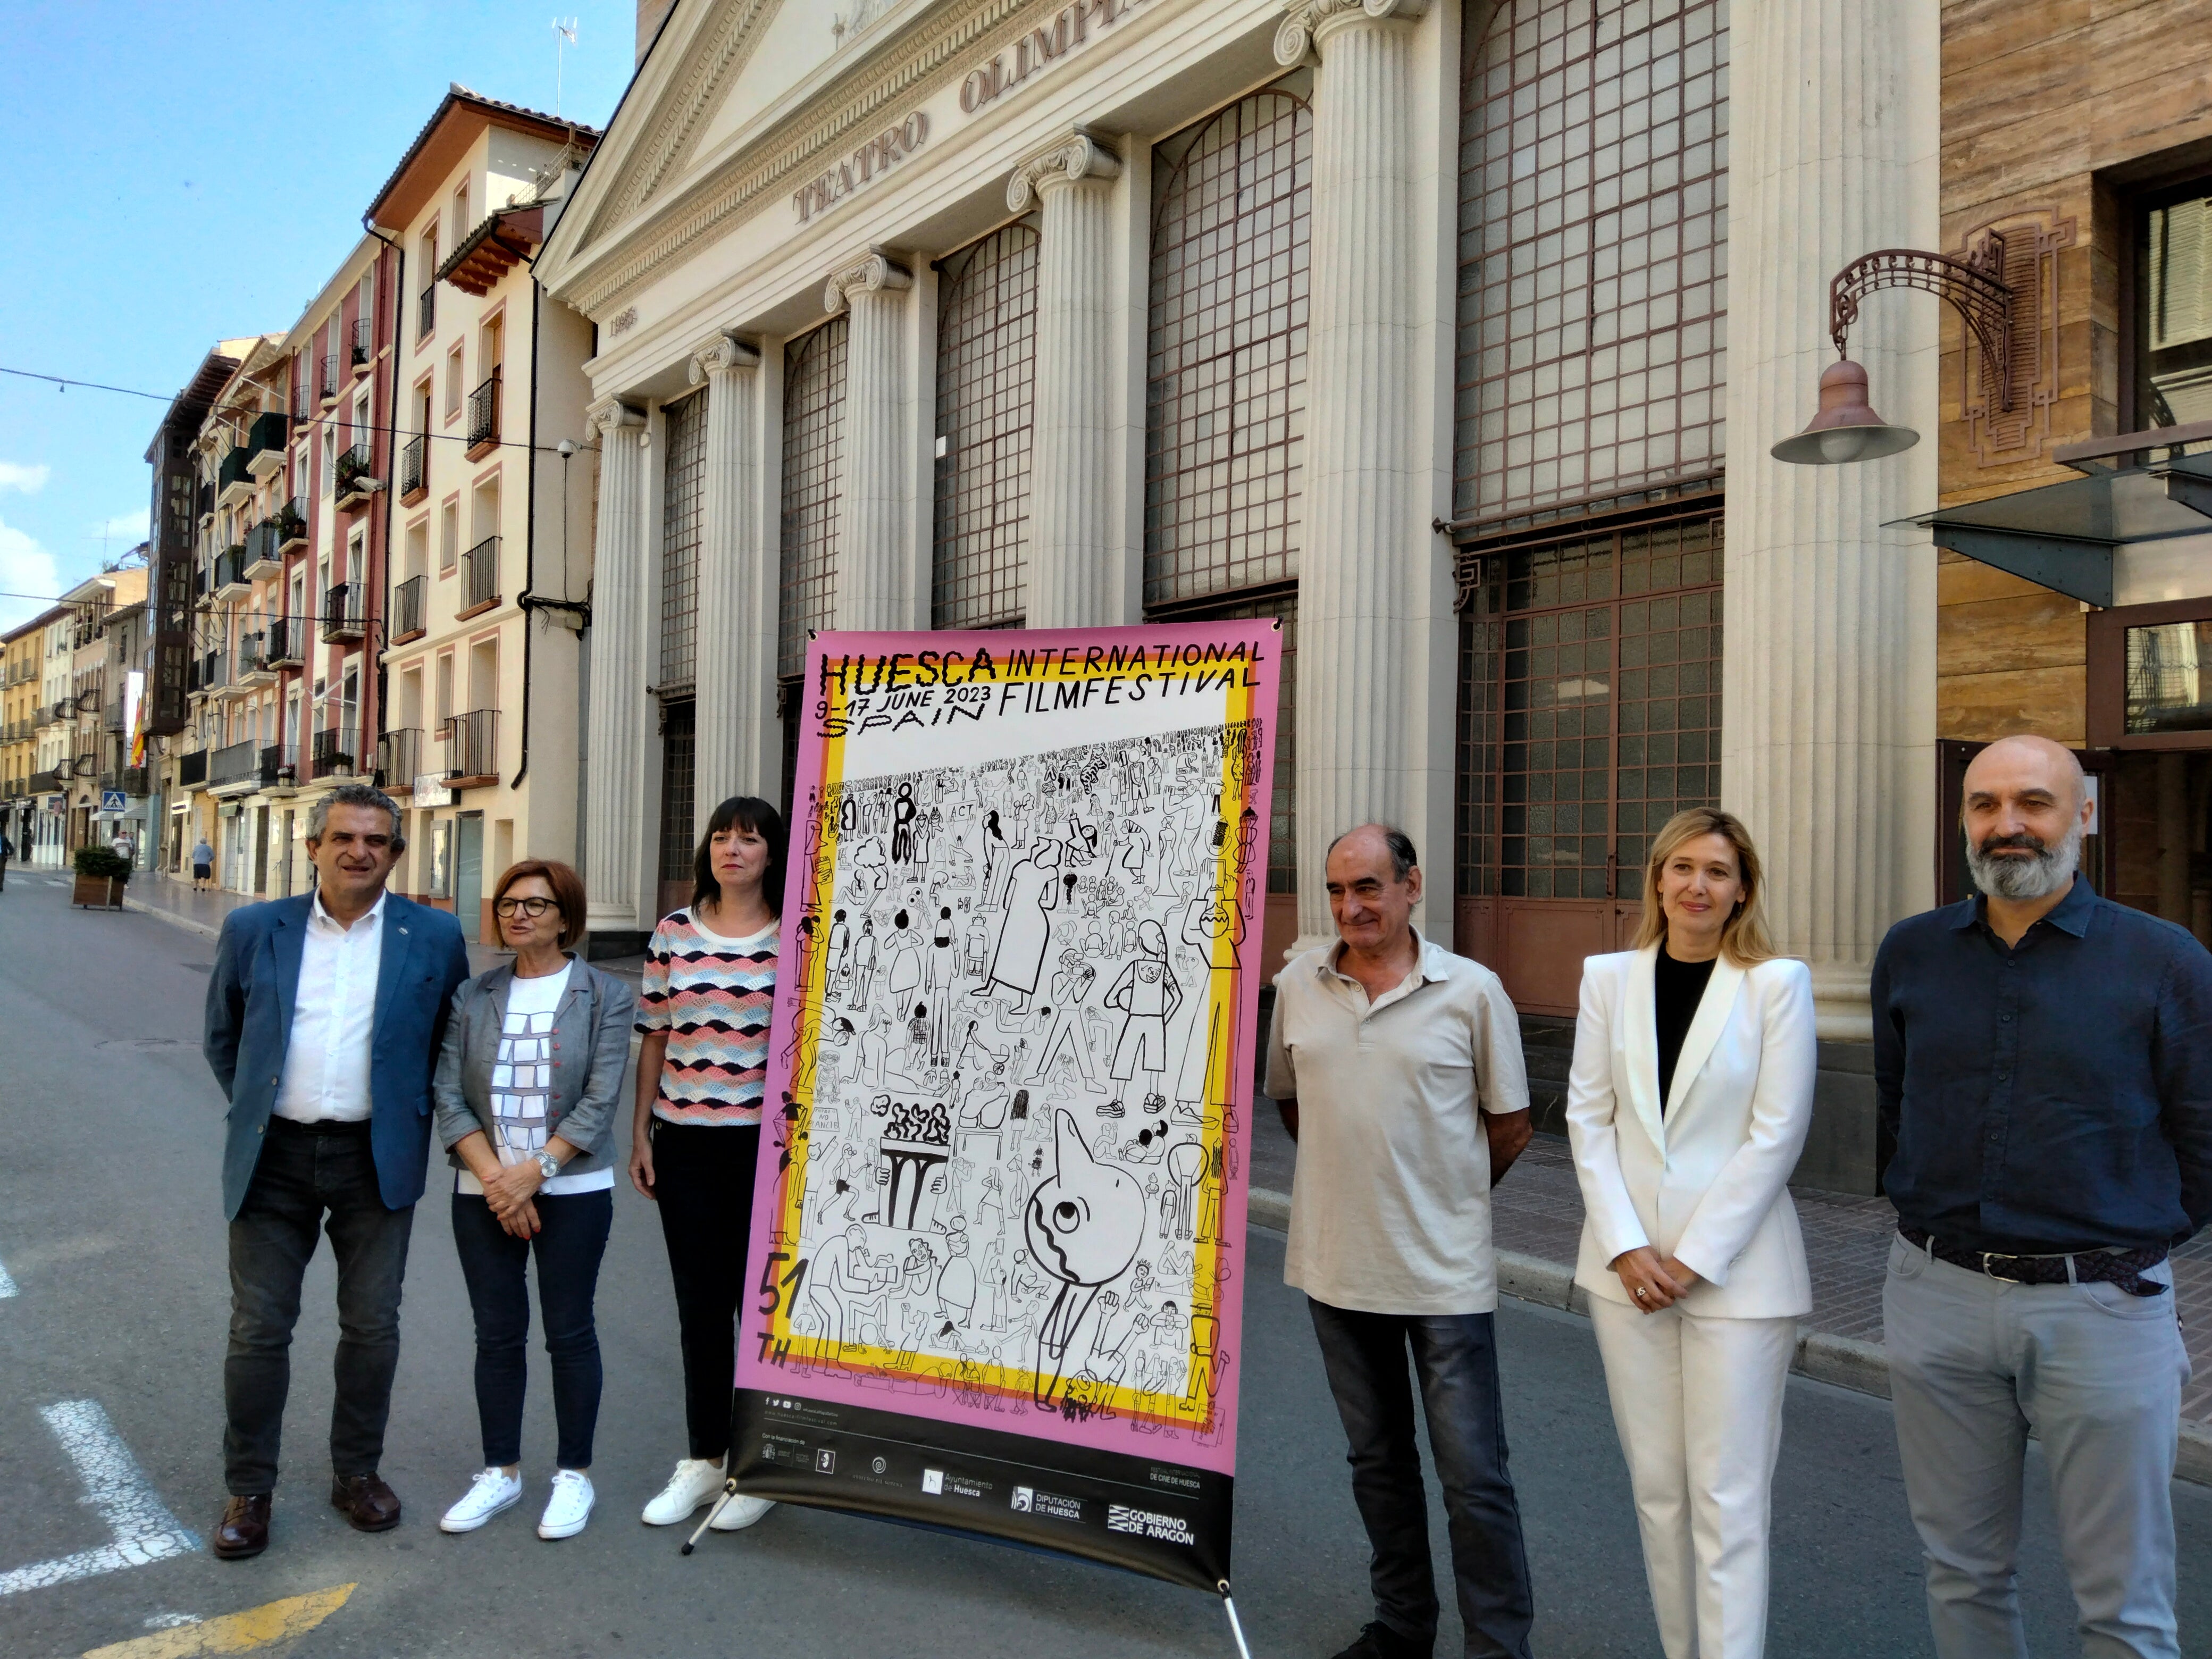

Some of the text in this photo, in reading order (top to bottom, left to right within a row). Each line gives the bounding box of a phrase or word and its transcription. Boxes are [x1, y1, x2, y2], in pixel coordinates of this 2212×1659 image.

[793, 0, 1143, 225] TEATRO OLIMPI
[820, 641, 1264, 696] HUESCA INTERNATIONAL
[876, 690, 935, 712] JUNE
[944, 686, 991, 704] 2023
[999, 667, 1261, 716] FILMFESTIVAL
[817, 703, 985, 738] SPAIN
[951, 804, 974, 819] ACT
[758, 1252, 809, 1319] 51
[757, 1331, 792, 1370] TH
[944, 1483, 981, 1497] de Huesca
[945, 1473, 993, 1489] Ayuntamiento
[1158, 1474, 1170, 1483] CINE
[1179, 1478, 1201, 1489] HUESCA
[1036, 1494, 1080, 1510] DIPUTACIÓN
[1036, 1503, 1080, 1520] DE HUESCA
[1128, 1521, 1143, 1535] DE
[1129, 1509, 1186, 1531] GOBIERNO
